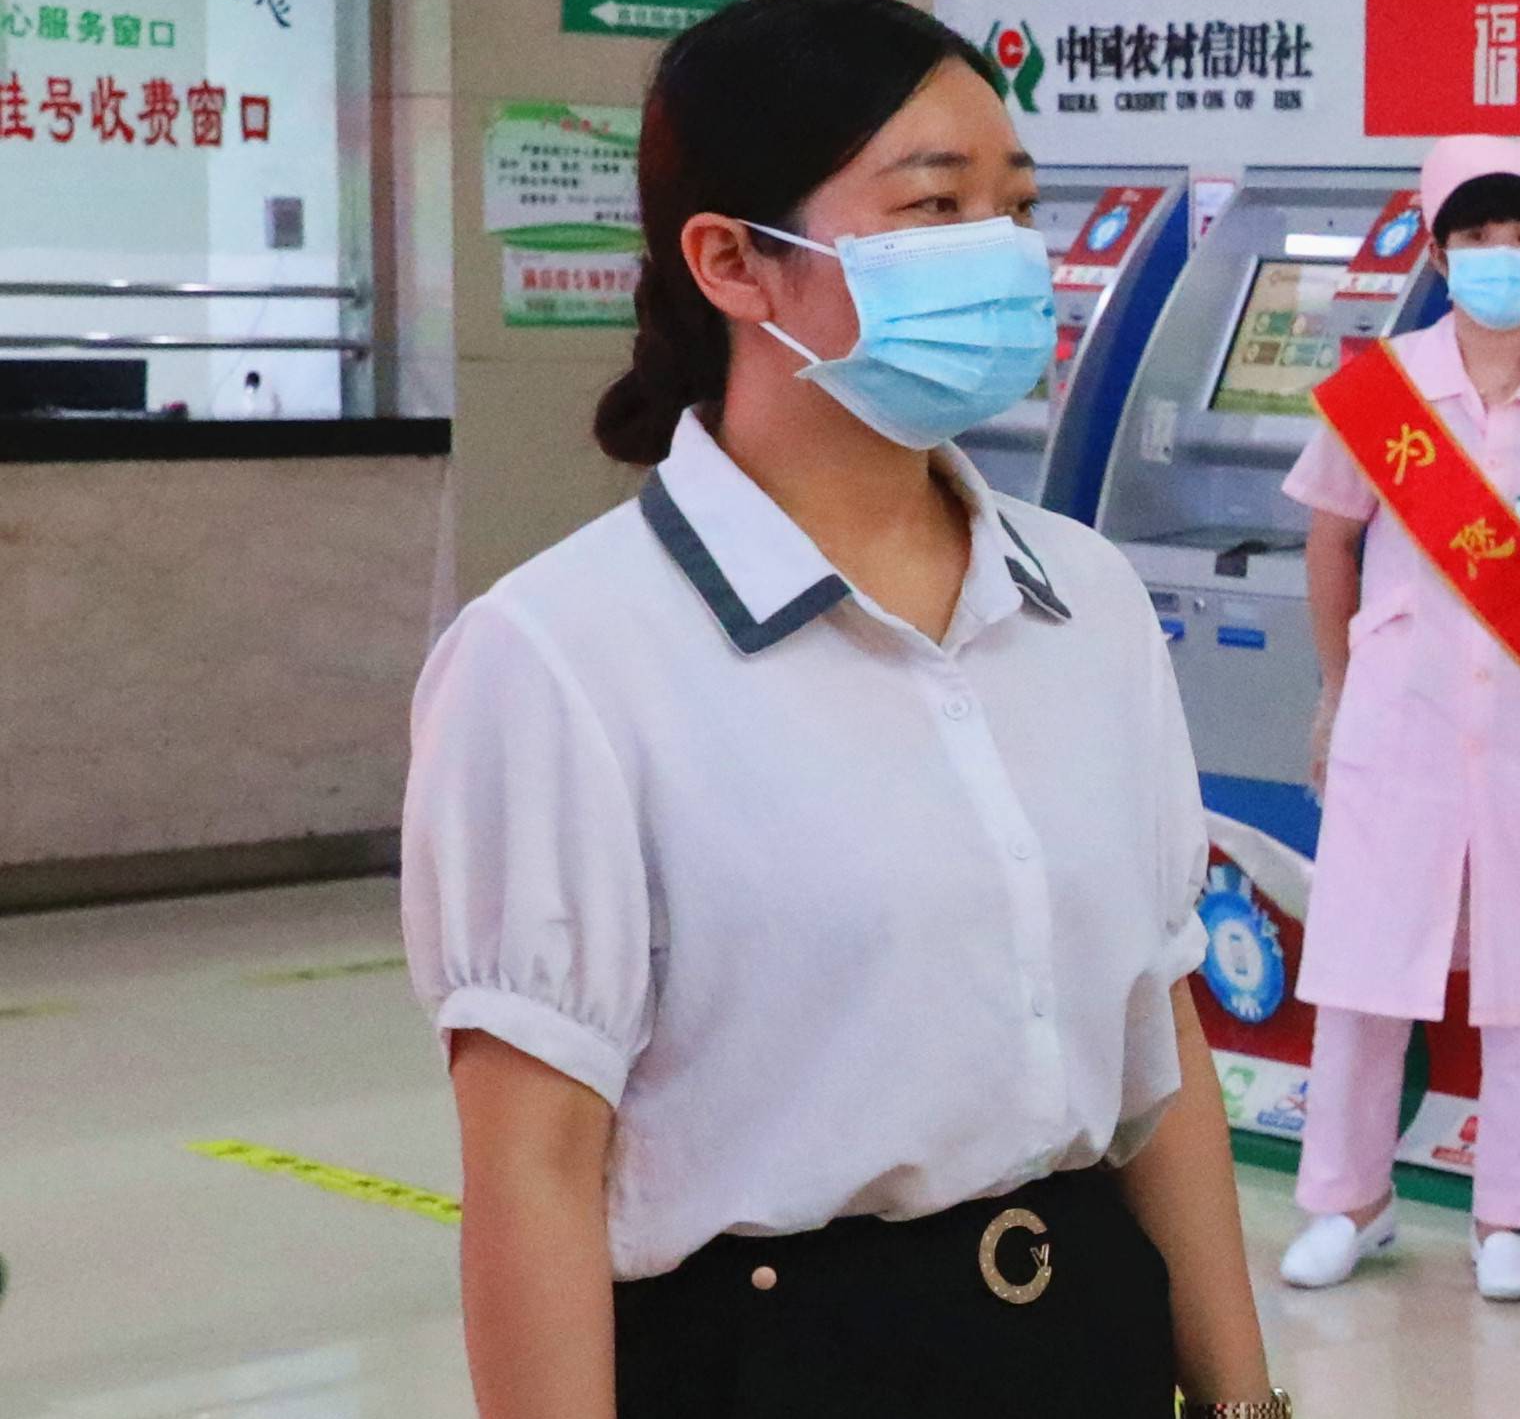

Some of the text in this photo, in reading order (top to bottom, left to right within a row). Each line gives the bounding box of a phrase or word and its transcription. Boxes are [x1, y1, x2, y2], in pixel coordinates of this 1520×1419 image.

[1056, 19, 1313, 83] 中国农村信用社
